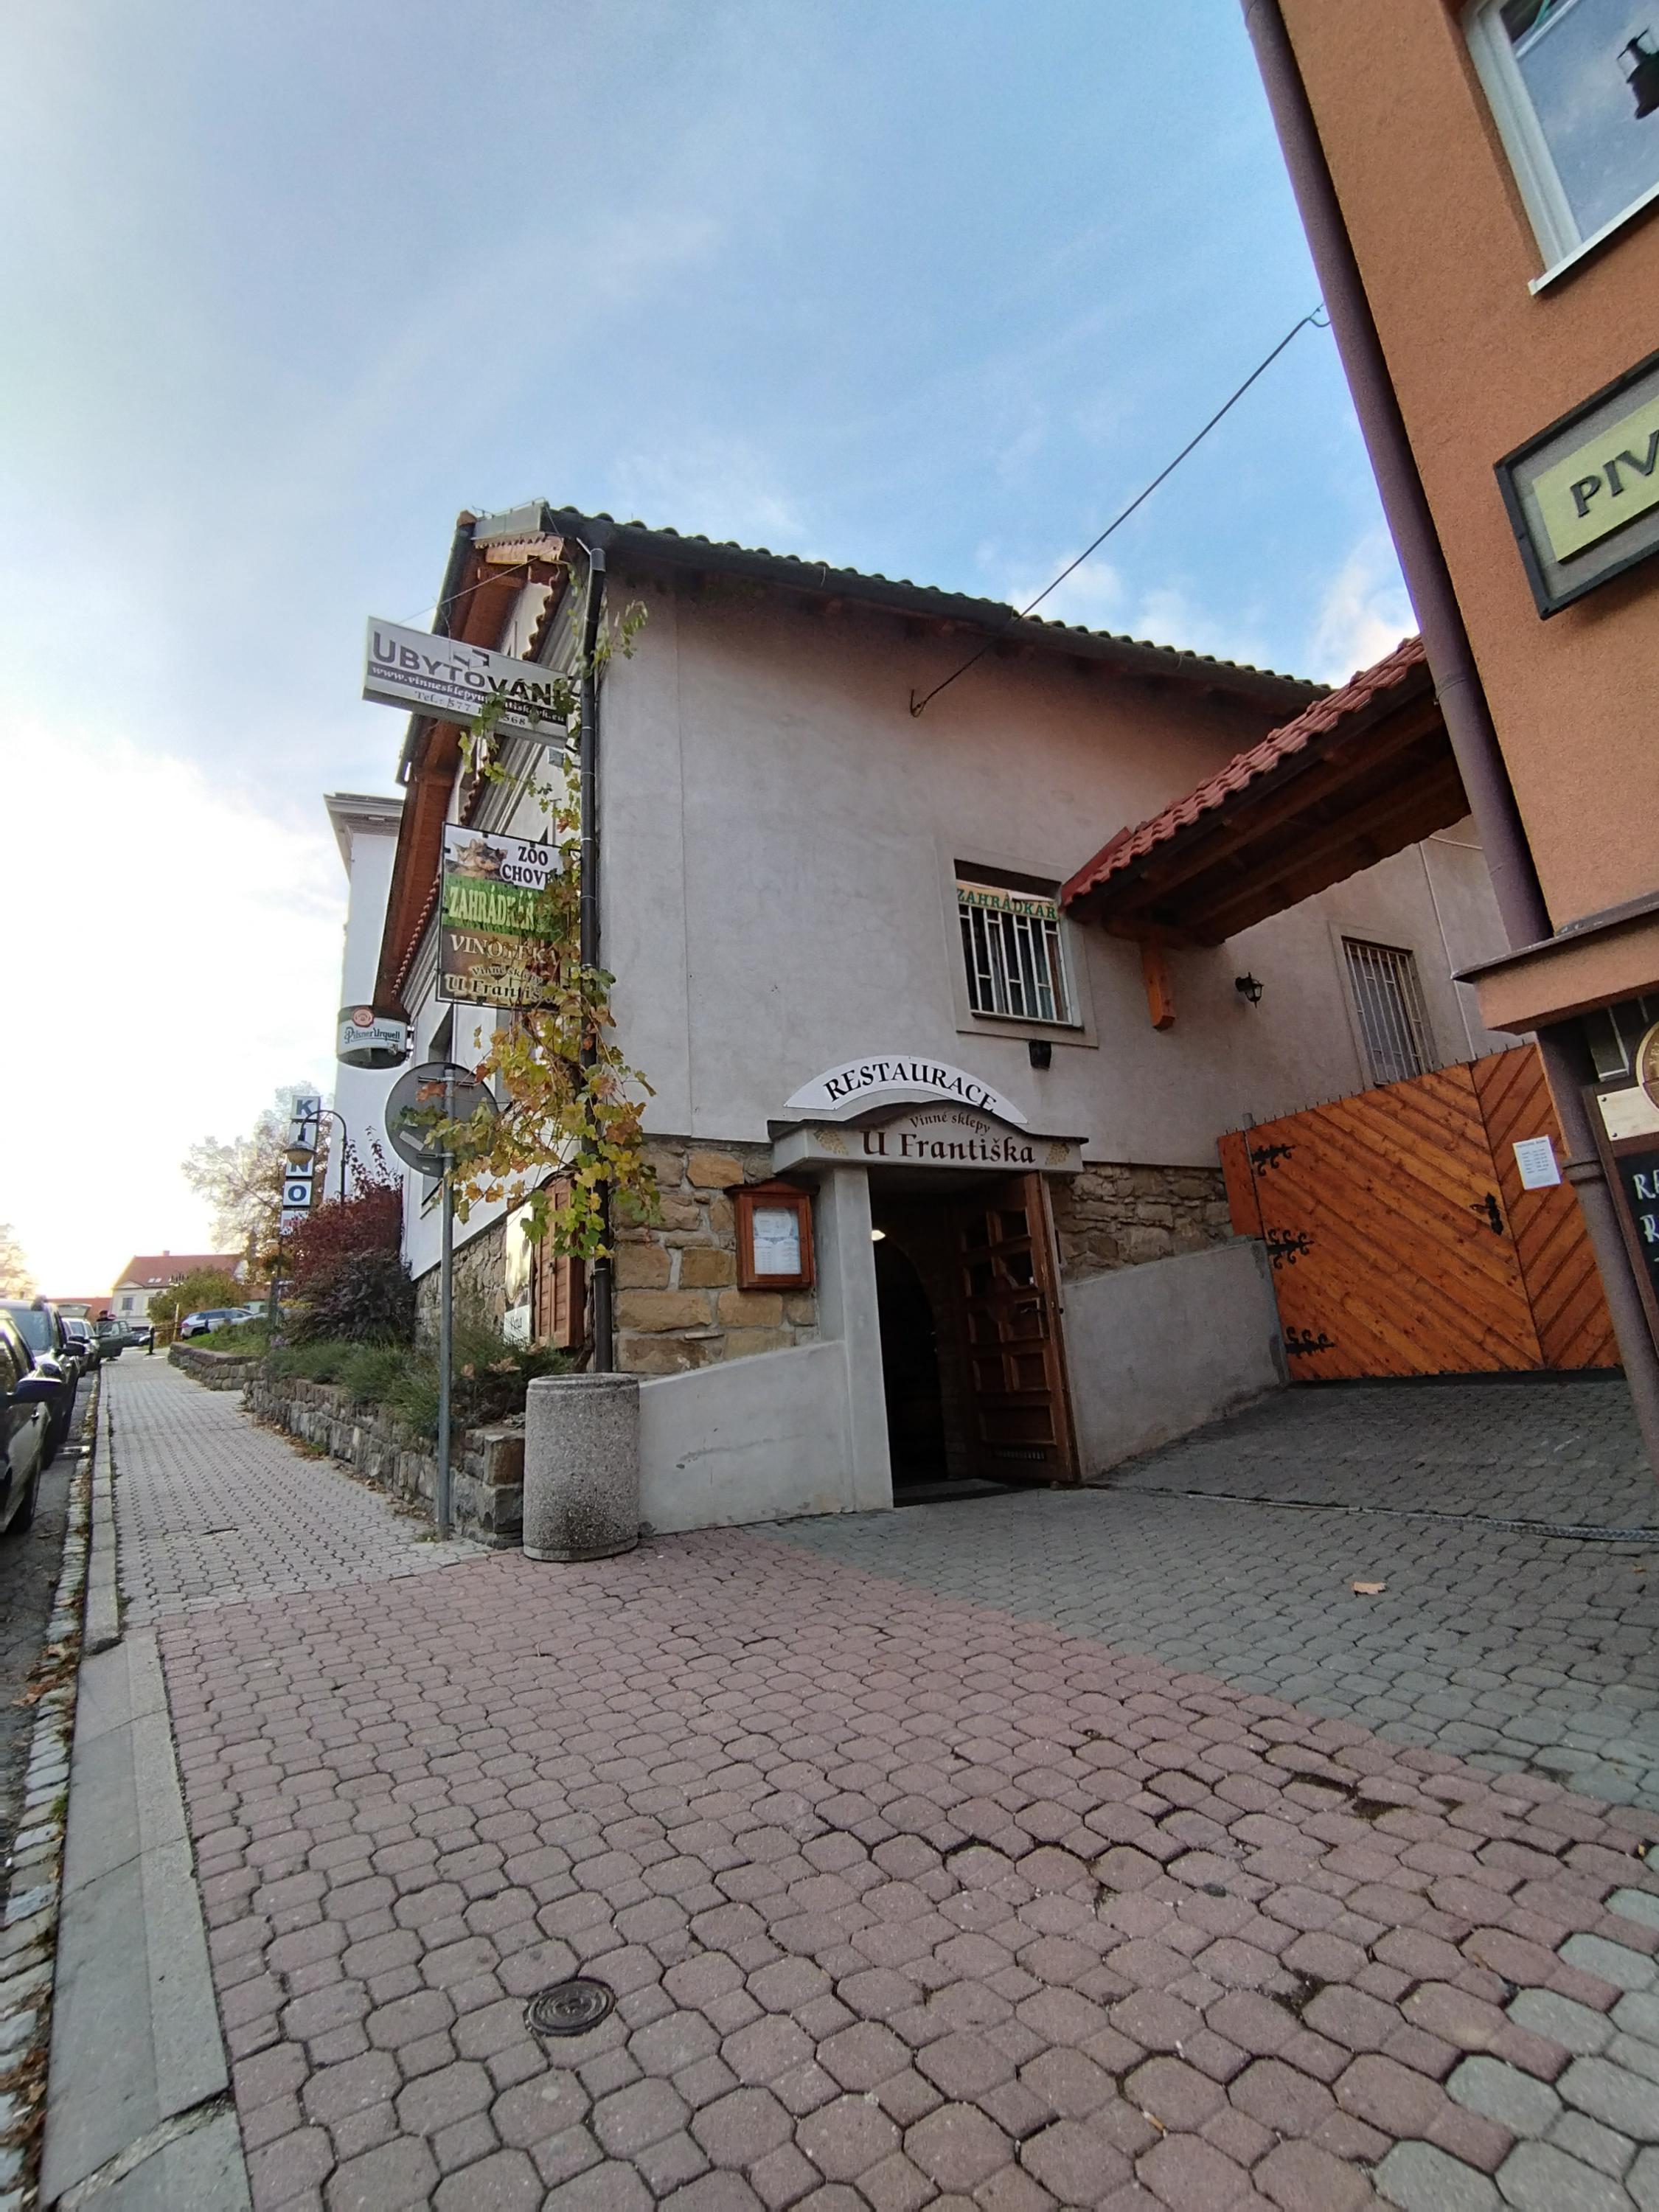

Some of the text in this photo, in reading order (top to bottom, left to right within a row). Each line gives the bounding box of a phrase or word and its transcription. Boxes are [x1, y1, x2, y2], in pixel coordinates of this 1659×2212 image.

[373, 631, 562, 708] UBYTOVÁN
[518, 846, 549, 866] ZOO
[448, 976, 465, 990] U
[344, 1026, 400, 1044] Pilsner Urquell
[823, 1062, 996, 1112] RESTAURACE
[909, 1112, 990, 1135] Vinné sklepy
[860, 1130, 1035, 1164] U Františka
